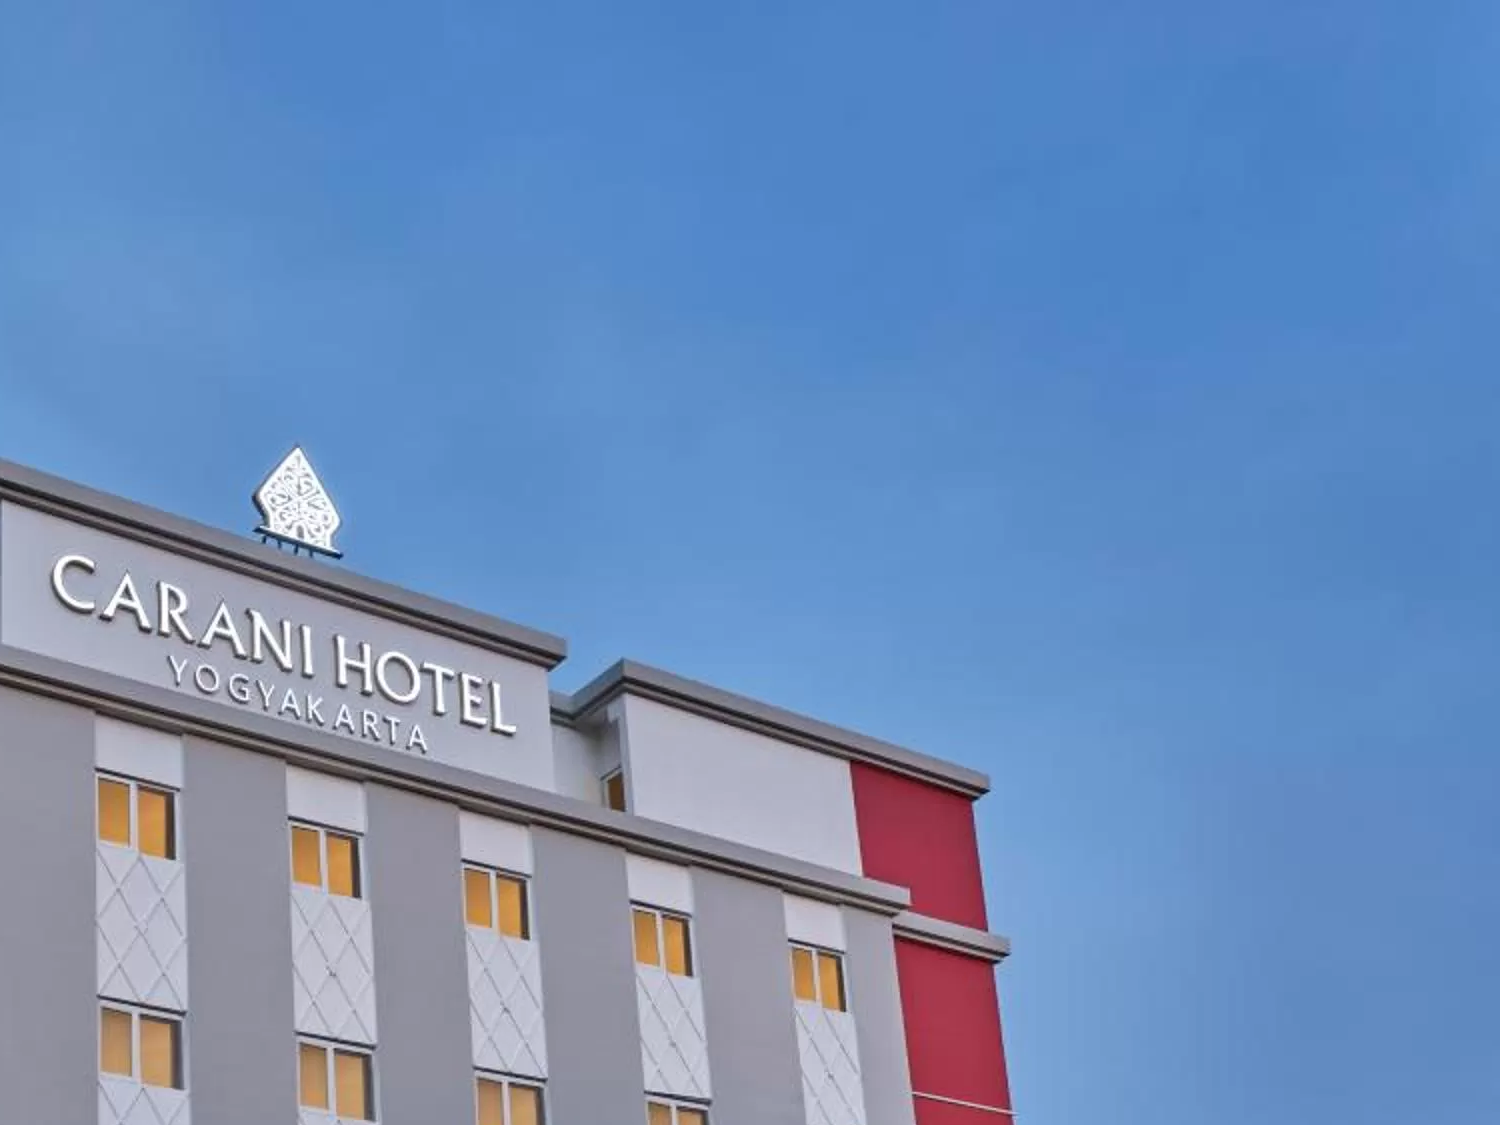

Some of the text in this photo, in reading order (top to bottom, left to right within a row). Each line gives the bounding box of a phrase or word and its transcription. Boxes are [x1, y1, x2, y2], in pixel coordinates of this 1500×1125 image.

[51, 554, 517, 735] CARANI HOTEL
[167, 655, 429, 753] YOGYAKARTA
